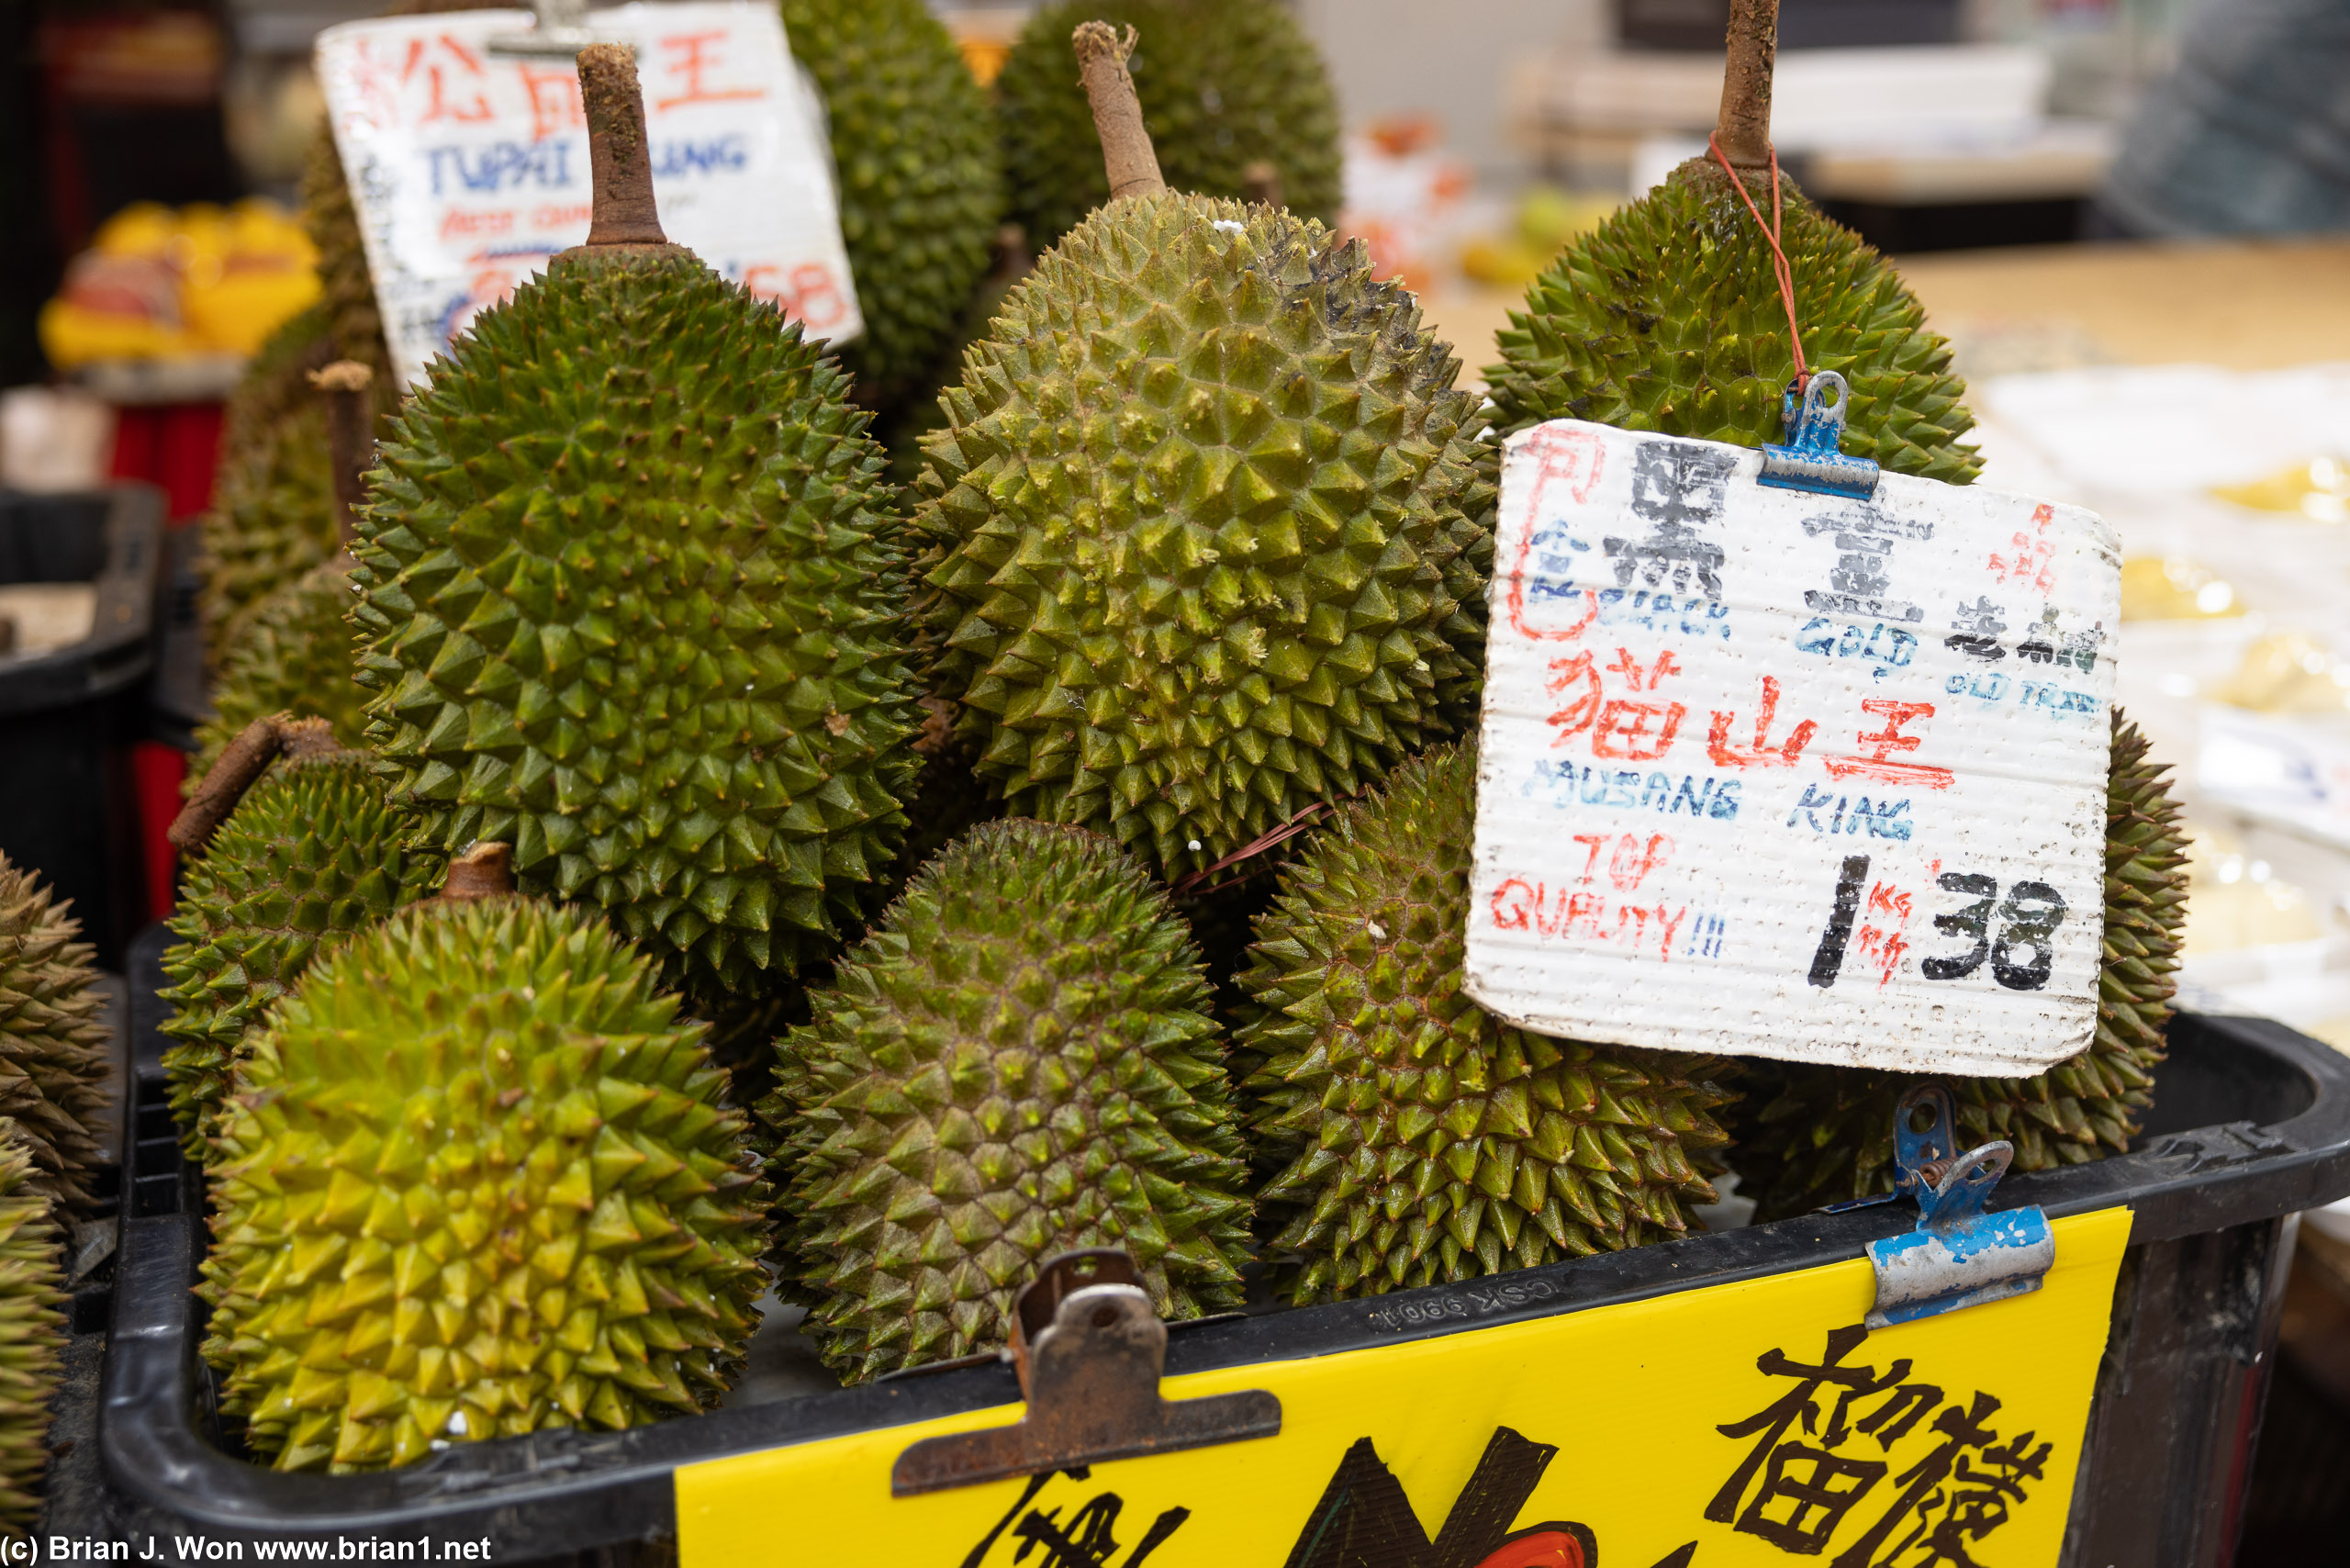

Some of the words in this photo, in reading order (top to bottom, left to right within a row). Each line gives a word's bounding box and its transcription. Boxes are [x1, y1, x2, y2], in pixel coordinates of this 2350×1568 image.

[1796, 616, 1919, 666] GOLD
[1945, 672, 2011, 700] OLD
[1545, 646, 1956, 790] 猫山王
[1522, 758, 1742, 821] MUSANG
[1786, 782, 1914, 842] KING
[1573, 833, 1675, 892] TOP
[1867, 880, 1913, 929] KG
[1921, 872, 2069, 991] 38
[1469, 1279, 1560, 1313] CSK
